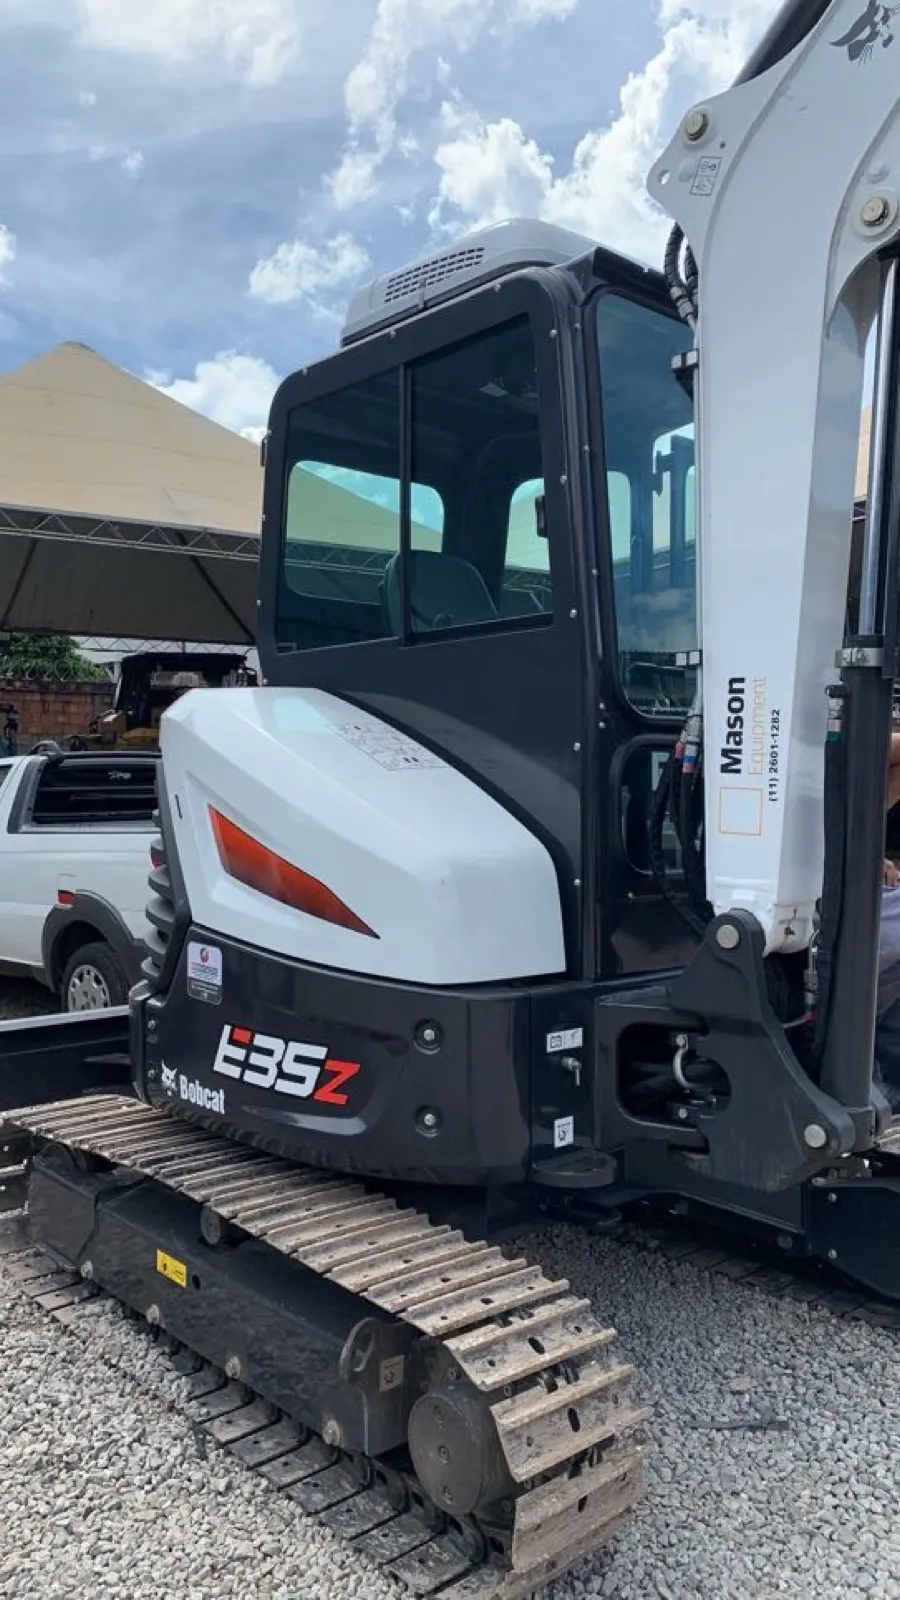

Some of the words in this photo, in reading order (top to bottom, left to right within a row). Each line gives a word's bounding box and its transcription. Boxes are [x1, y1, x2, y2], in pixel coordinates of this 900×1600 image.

[720, 677, 745, 774] Mason
[748, 676, 767, 775] Equipment
[769, 708, 780, 774] 2601-1282
[769, 778, 779, 802] (11)
[179, 1074, 225, 1115] Bobcat
